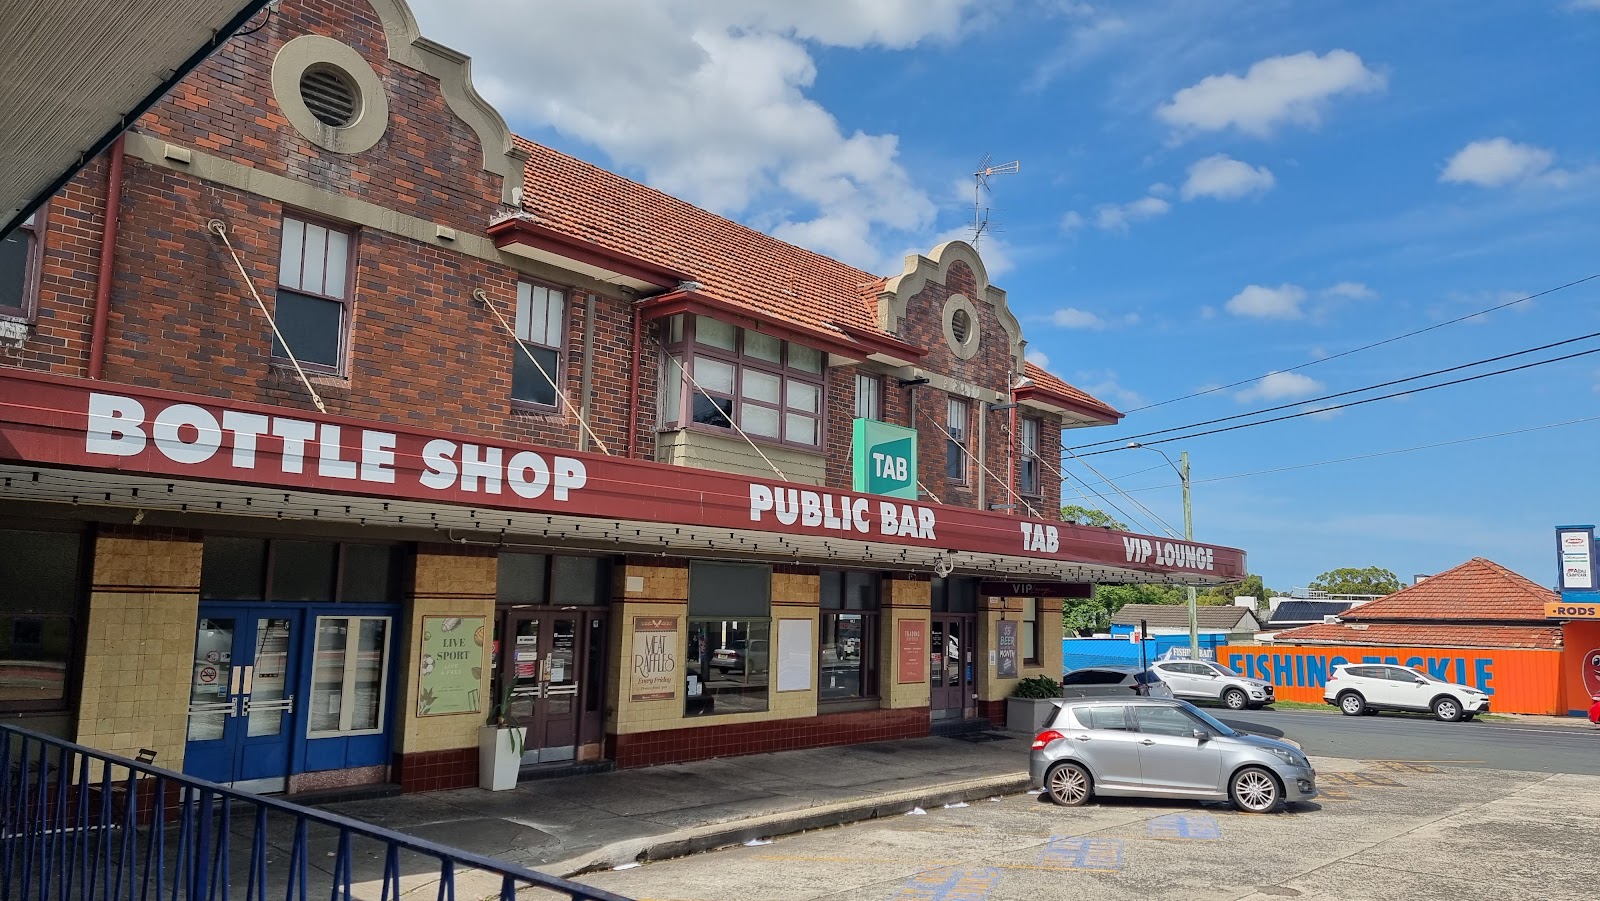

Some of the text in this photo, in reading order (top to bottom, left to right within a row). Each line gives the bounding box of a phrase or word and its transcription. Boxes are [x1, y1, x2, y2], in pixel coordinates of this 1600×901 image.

[86, 392, 587, 501] BOTTLE SHOP
[873, 452, 908, 482] TAB
[750, 483, 936, 540] PUBLIC BAR
[1020, 521, 1059, 553] TAB
[1122, 536, 1214, 570] VIP LOUNGE
[1012, 583, 1033, 593] VIP
[1557, 606, 1596, 616] RODS
[442, 638, 466, 648] LIVE
[644, 635, 668, 655] MEAT
[1000, 636, 1015, 646] BEER
[436, 650, 470, 661] SPORT
[1000, 650, 1016, 658] MONTH
[1172, 647, 1192, 657] FISHIN
[634, 653, 675, 679] RAFFLES
[638, 676, 672, 686] Every Friday
